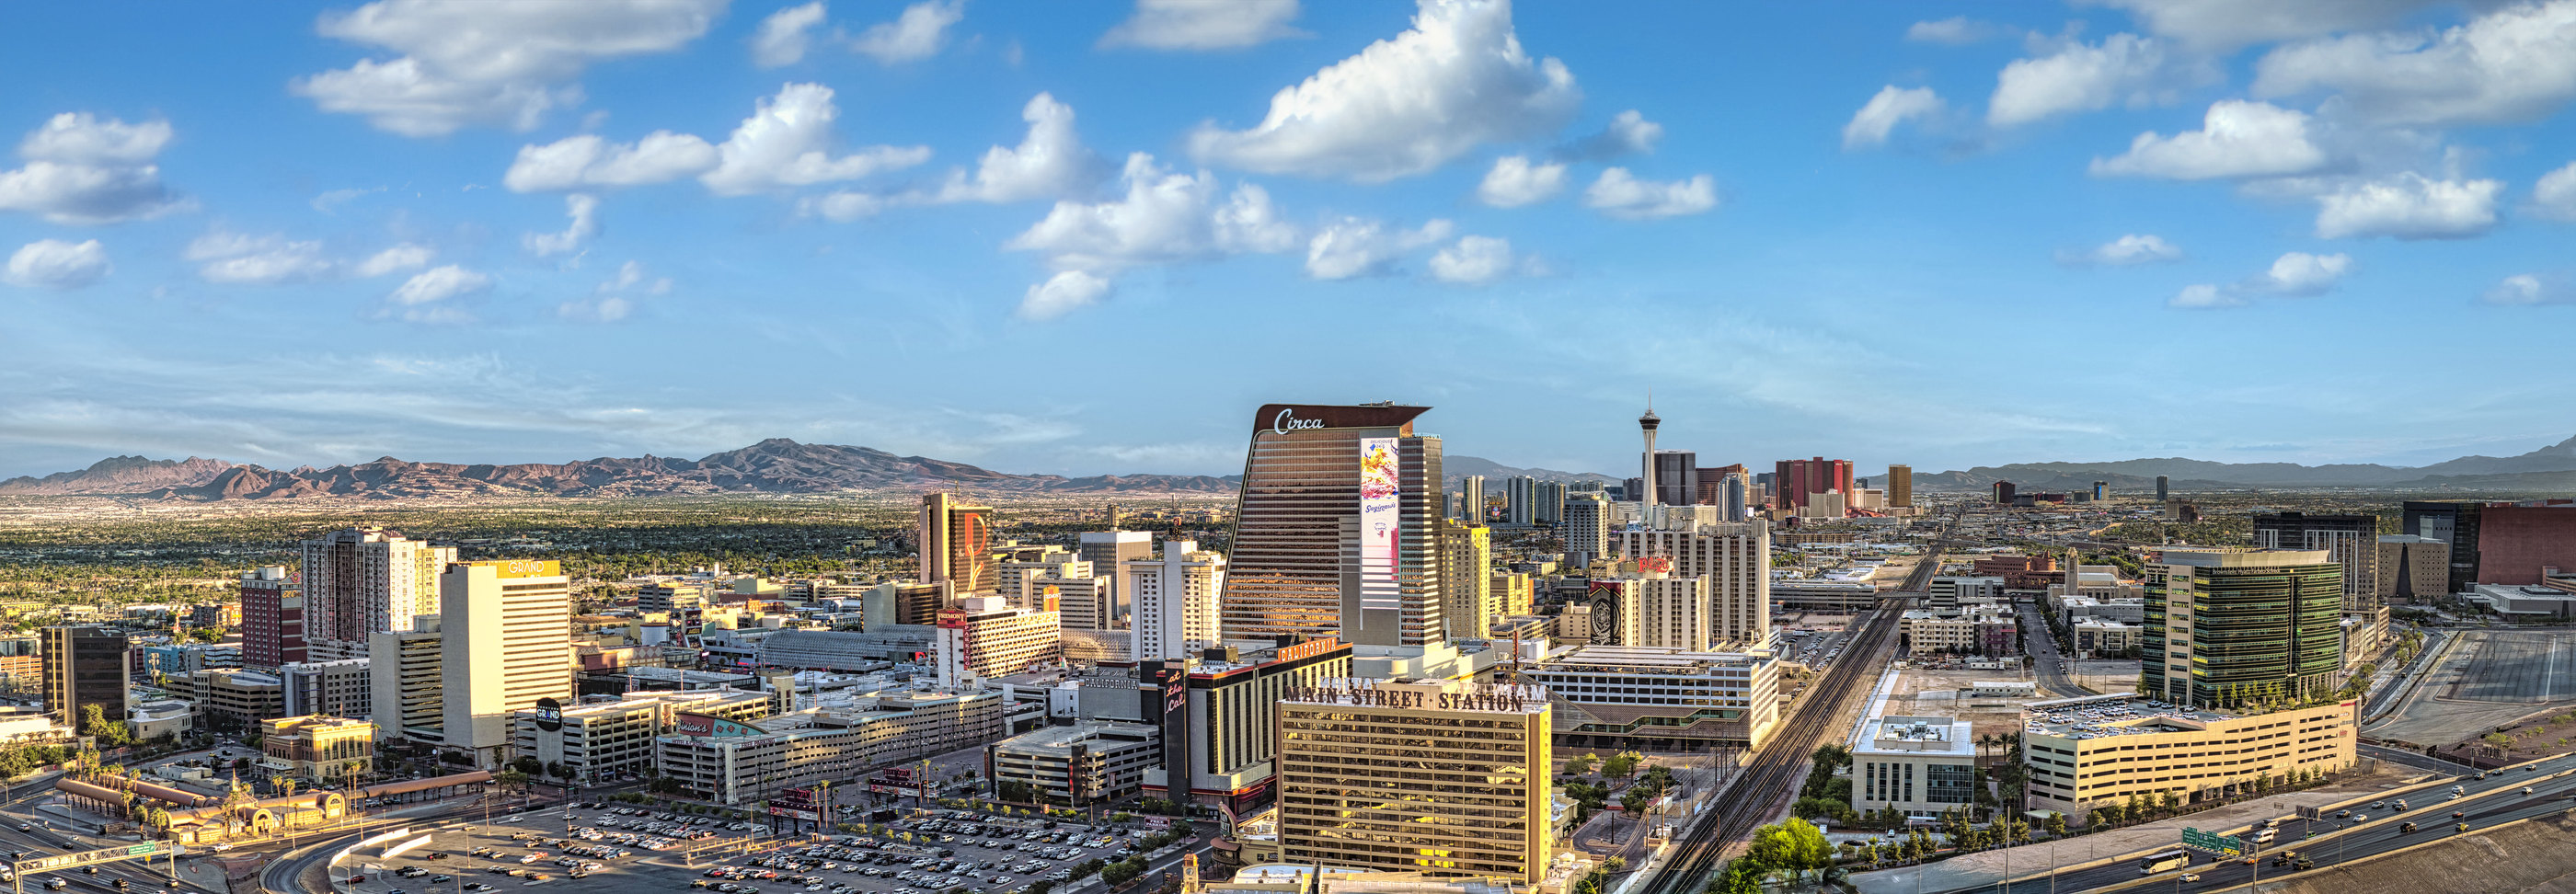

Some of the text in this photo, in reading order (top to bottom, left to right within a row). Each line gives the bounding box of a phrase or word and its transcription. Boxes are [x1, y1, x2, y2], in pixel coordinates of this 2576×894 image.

[1274, 408, 1325, 435] Circa
[965, 512, 987, 556] D
[509, 561, 545, 573] GRAND
[1637, 556, 1670, 573] Plaza
[1043, 593, 1062, 602] FREMONT
[937, 613, 965, 622] FREMONT
[1281, 638, 1336, 662] CALIFORNIA
[1167, 670, 1182, 683] at
[1086, 679, 1138, 690] CALIFORNIA
[1167, 683, 1183, 697] the
[1166, 693, 1185, 715] Cal
[1285, 685, 1523, 713] MAIN STREET STATION
[536, 708, 559, 719] GRAND
[676, 719, 708, 733] Binion's
[755, 738, 776, 746] PARKING
